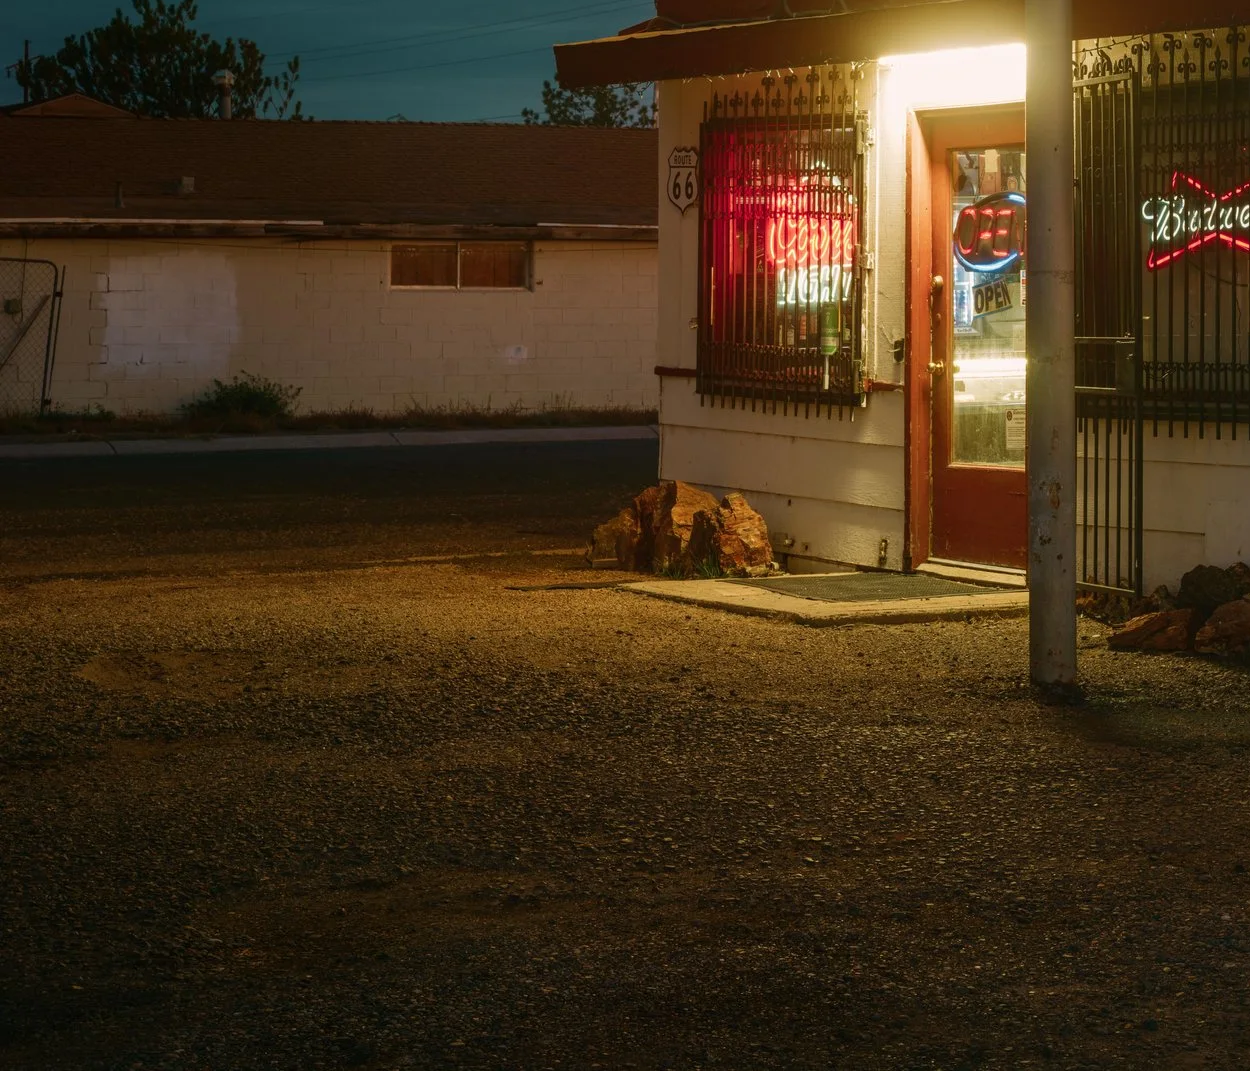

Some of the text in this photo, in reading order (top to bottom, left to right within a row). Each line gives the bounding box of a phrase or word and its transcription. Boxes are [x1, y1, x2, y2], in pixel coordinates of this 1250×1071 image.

[674, 153, 693, 166] ROUTE
[672, 171, 694, 200] 66
[975, 280, 1012, 315] OPEN
